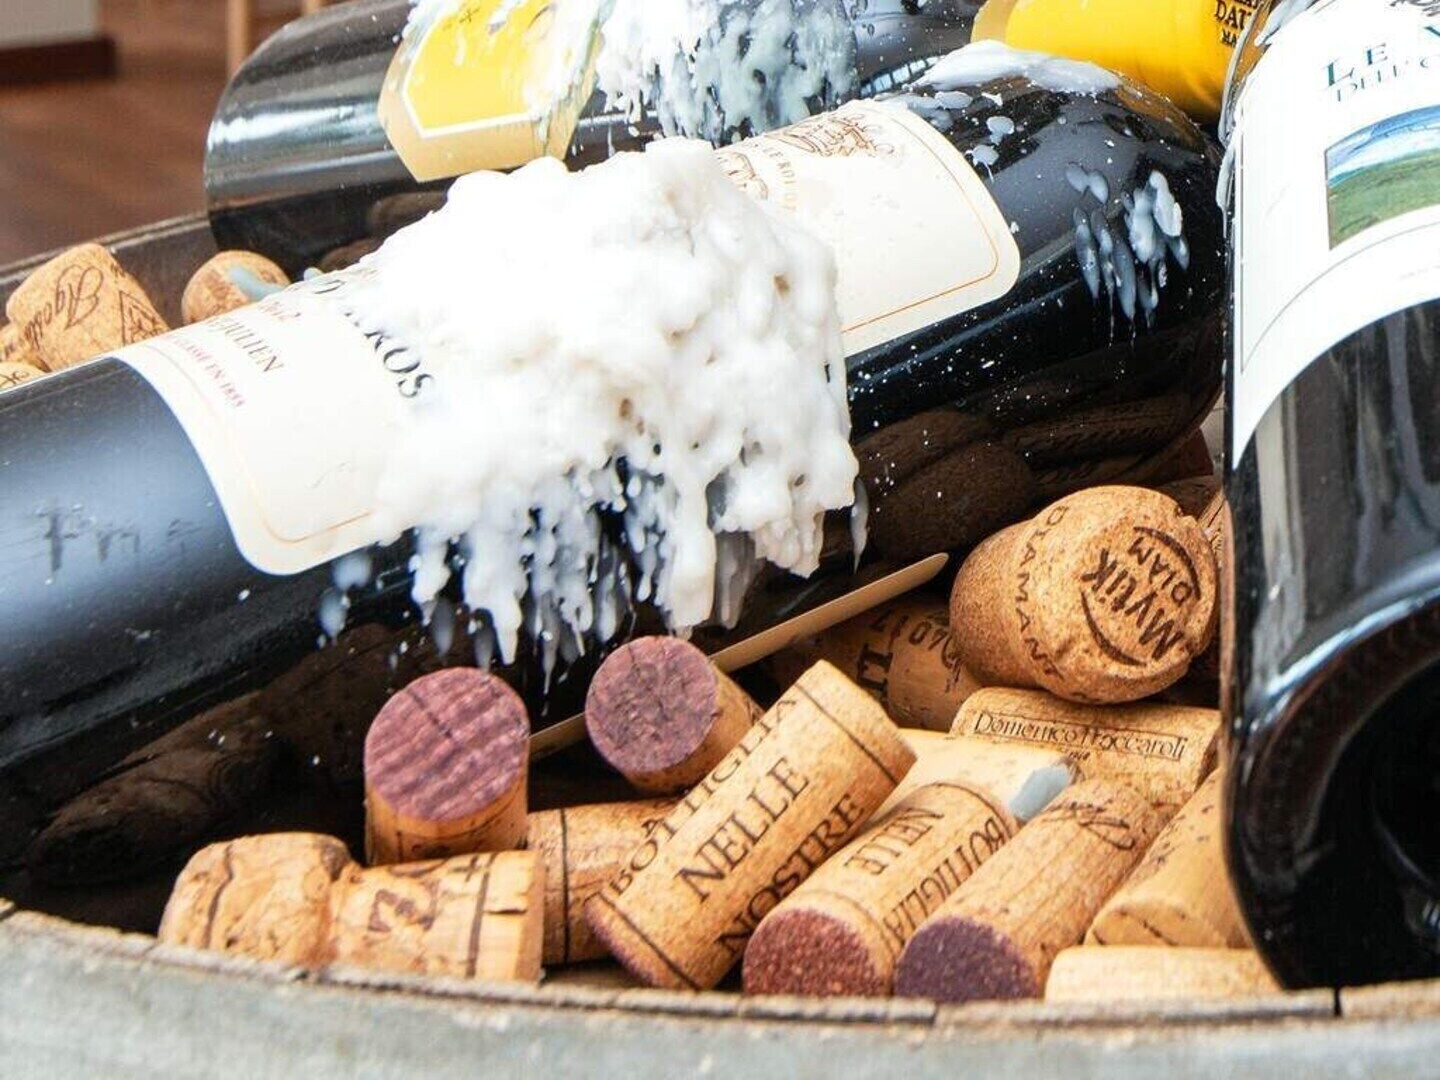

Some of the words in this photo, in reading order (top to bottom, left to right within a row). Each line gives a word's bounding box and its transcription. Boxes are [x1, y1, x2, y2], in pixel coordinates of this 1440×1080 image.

[1322, 42, 1388, 88] LE
[1127, 535, 1193, 607] DIAM
[974, 711, 1077, 744] Domenico
[674, 758, 808, 901] NELLE
[714, 793, 861, 957] NOSTRE
